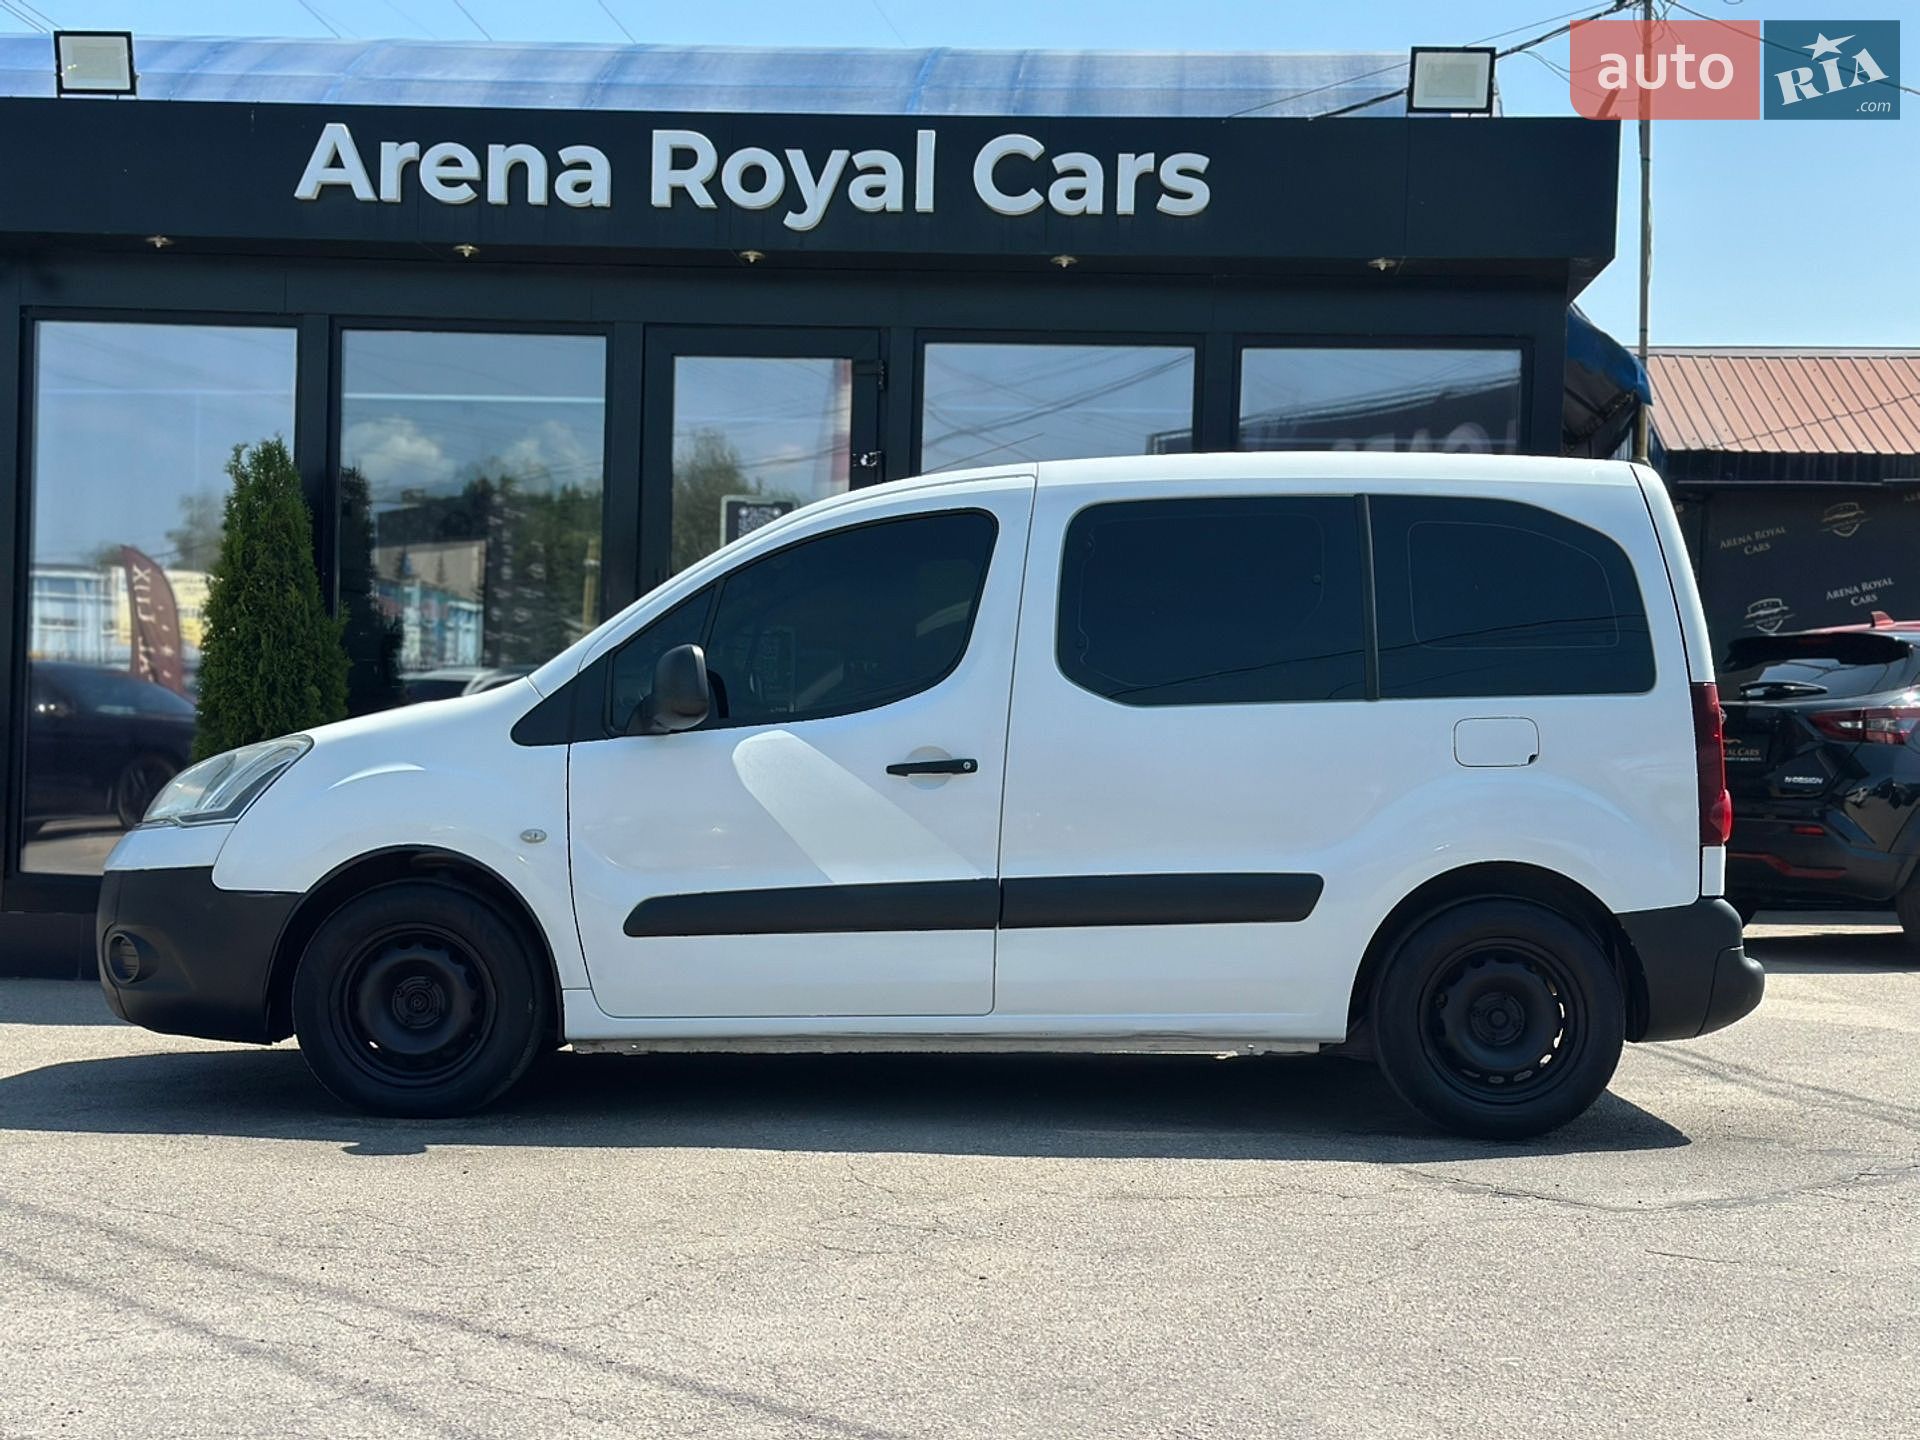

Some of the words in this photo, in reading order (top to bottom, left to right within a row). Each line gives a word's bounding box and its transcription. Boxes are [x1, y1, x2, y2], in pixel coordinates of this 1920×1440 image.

[294, 122, 612, 208] Arena
[651, 129, 936, 231] Royal
[973, 133, 1211, 216] Cars
[1850, 594, 1878, 606] CARS
